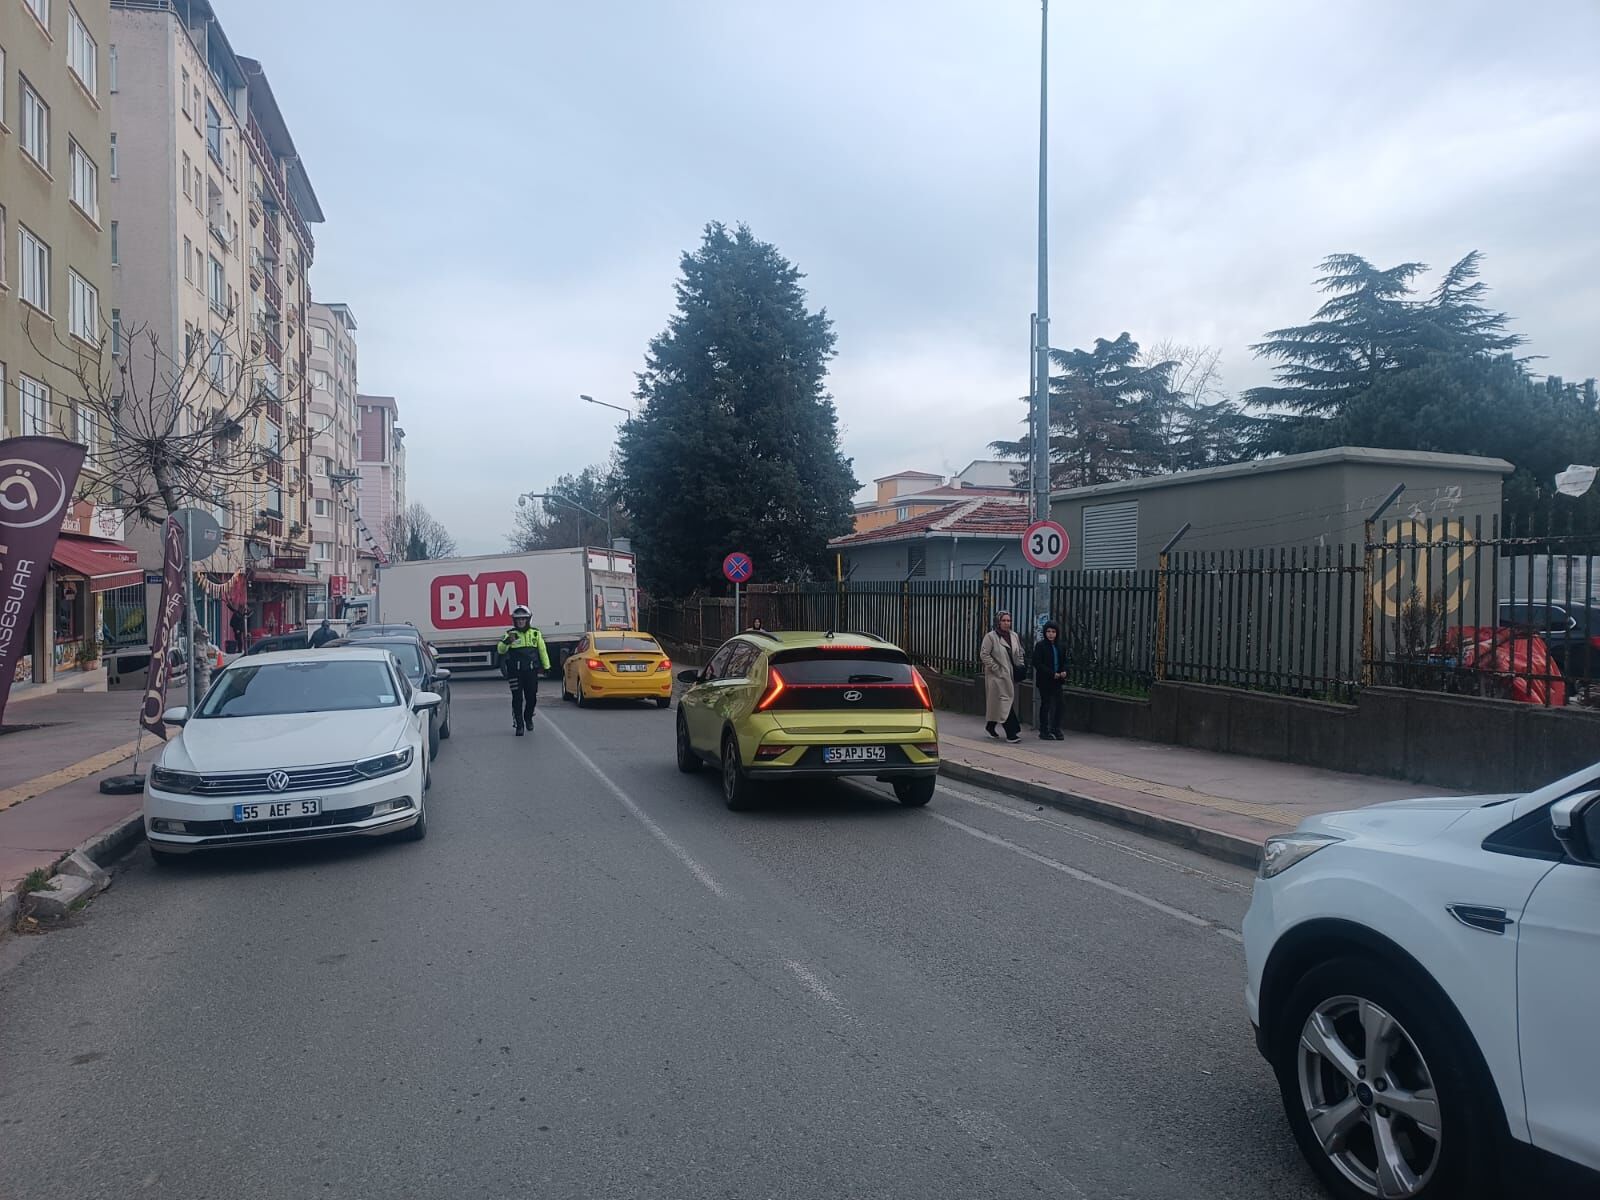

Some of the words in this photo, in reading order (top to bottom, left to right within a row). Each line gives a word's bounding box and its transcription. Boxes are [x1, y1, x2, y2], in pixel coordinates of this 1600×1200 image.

[1031, 533, 1060, 555] 30
[439, 580, 518, 621] BIM
[0, 559, 35, 667] KSESUAR
[829, 748, 842, 759] 55
[845, 747, 863, 758] APJ
[866, 747, 885, 758] 542
[243, 806, 258, 819] 55
[269, 803, 291, 817] AEF
[301, 801, 317, 814] 53
